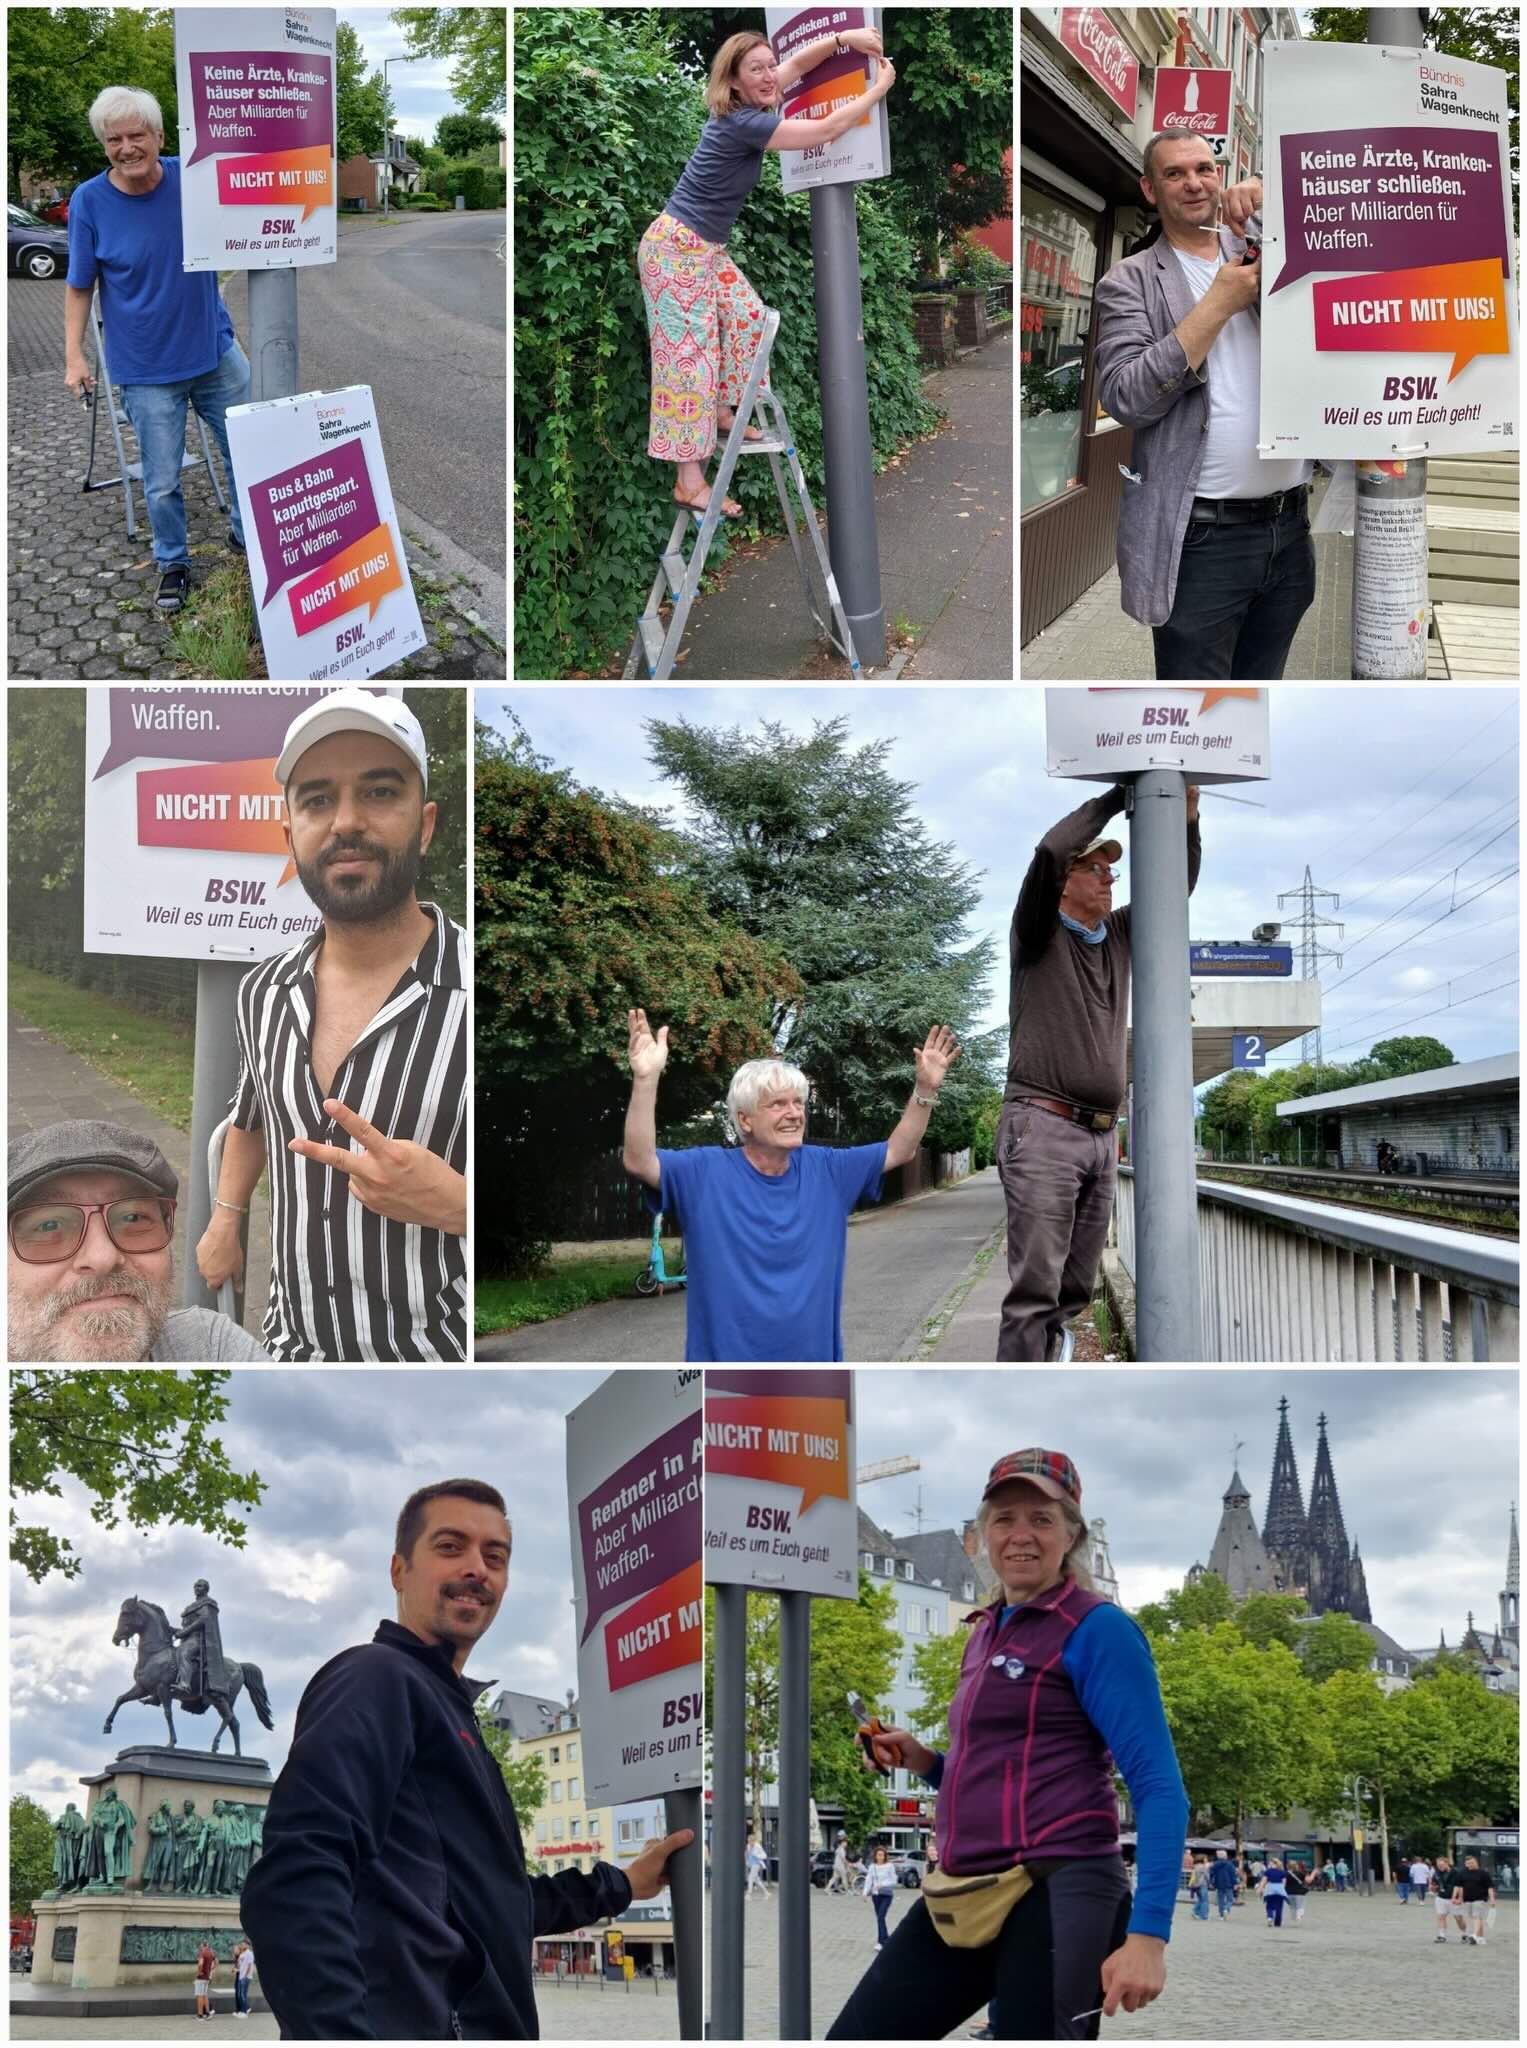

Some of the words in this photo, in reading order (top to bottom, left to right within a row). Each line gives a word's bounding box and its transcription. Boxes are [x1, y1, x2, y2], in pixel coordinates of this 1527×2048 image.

[285, 19, 309, 33] Sahra
[832, 10, 847, 24] an
[285, 29, 333, 50] Wagenknecht
[204, 66, 244, 81] Keine
[248, 64, 285, 84] Ärzte,
[287, 68, 328, 86] Kranken-
[1419, 66, 1465, 88] Bündnis
[206, 86, 253, 100] häuser
[258, 86, 313, 102] schließen.
[1420, 83, 1457, 101] Sahra
[208, 105, 237, 119] Aber
[240, 104, 294, 119] Milliarden
[295, 106, 308, 119] für
[809, 101, 829, 118] MIT
[1420, 97, 1500, 124] Wagenknecht
[209, 124, 256, 138] Waffen.
[1300, 150, 1357, 170] Keine
[1362, 145, 1419, 171] Ärzte,
[1423, 149, 1493, 173] Kranken-
[229, 172, 275, 189] NICHT
[278, 171, 302, 186] MIT
[304, 169, 327, 185] UNS!
[1302, 176, 1371, 197] häuser
[1377, 174, 1467, 197] schließen.
[1303, 203, 1345, 224] Aber
[1351, 202, 1434, 222] Milliarden
[1437, 202, 1458, 222] für
[261, 219, 296, 235] BSW.
[225, 239, 248, 251] Weil
[249, 240, 262, 250] es
[264, 240, 280, 249] um
[282, 237, 302, 249] Euch
[303, 236, 321, 249] geht!
[1304, 230, 1374, 251] Waffen.
[1332, 300, 1403, 326] NICHT
[1410, 298, 1448, 322] MIT
[1453, 297, 1496, 321] UNS!
[1383, 376, 1438, 401] BSW.
[319, 418, 342, 431] Sahra
[1324, 407, 1359, 426] Weil
[1363, 411, 1383, 426] es
[1387, 410, 1413, 425] um
[1416, 406, 1447, 425] Euch
[1449, 404, 1482, 426] geht!
[320, 420, 372, 441] Wagenknecht
[268, 484, 294, 504] Bus
[294, 477, 304, 494] &
[304, 467, 334, 489] Bahn
[272, 476, 360, 525] kaputtgespart.
[279, 522, 305, 546] Aber
[306, 499, 357, 533] Milliarden
[283, 547, 300, 567] für
[301, 529, 342, 556] Waffen.
[300, 581, 337, 616] NICHT
[338, 568, 361, 593] MIT
[362, 551, 390, 579] UNS!
[329, 661, 340, 674] es
[341, 652, 354, 668] um
[355, 642, 375, 660] Euch
[376, 627, 397, 650] geht!
[335, 623, 366, 654] BSW.
[130, 703, 221, 731] Waffen.
[1142, 707, 1190, 727] BSW.
[1096, 731, 1123, 748] Weil
[1126, 732, 1142, 745] es
[1146, 731, 1166, 744] um
[1170, 730, 1200, 746] Euch
[1202, 734, 1233, 750] geht!
[155, 793, 232, 821] NICHT
[239, 794, 285, 821] MIT
[204, 878, 267, 906] BSW.
[145, 905, 181, 925] Weil
[183, 910, 203, 926] es
[207, 911, 234, 928] um
[238, 911, 278, 930] Euch
[1245, 1036, 1261, 1060] 2
[704, 1422, 763, 1450] NICHT
[767, 1428, 800, 1455] MIT
[804, 1433, 839, 1461] UNS!
[591, 1468, 657, 1532] Rentner
[663, 1453, 684, 1480] in
[746, 1505, 791, 1534] BSW.
[595, 1523, 627, 1562] Aber
[730, 1536, 746, 1550] es
[750, 1539, 770, 1554] um
[772, 1538, 800, 1558] Euch
[802, 1546, 830, 1563] geht!
[596, 1541, 655, 1590] Waffen.
[617, 1612, 672, 1662] NICHT
[621, 1741, 646, 1766] Weil
[650, 1740, 664, 1759] es
[668, 1733, 690, 1753] um
